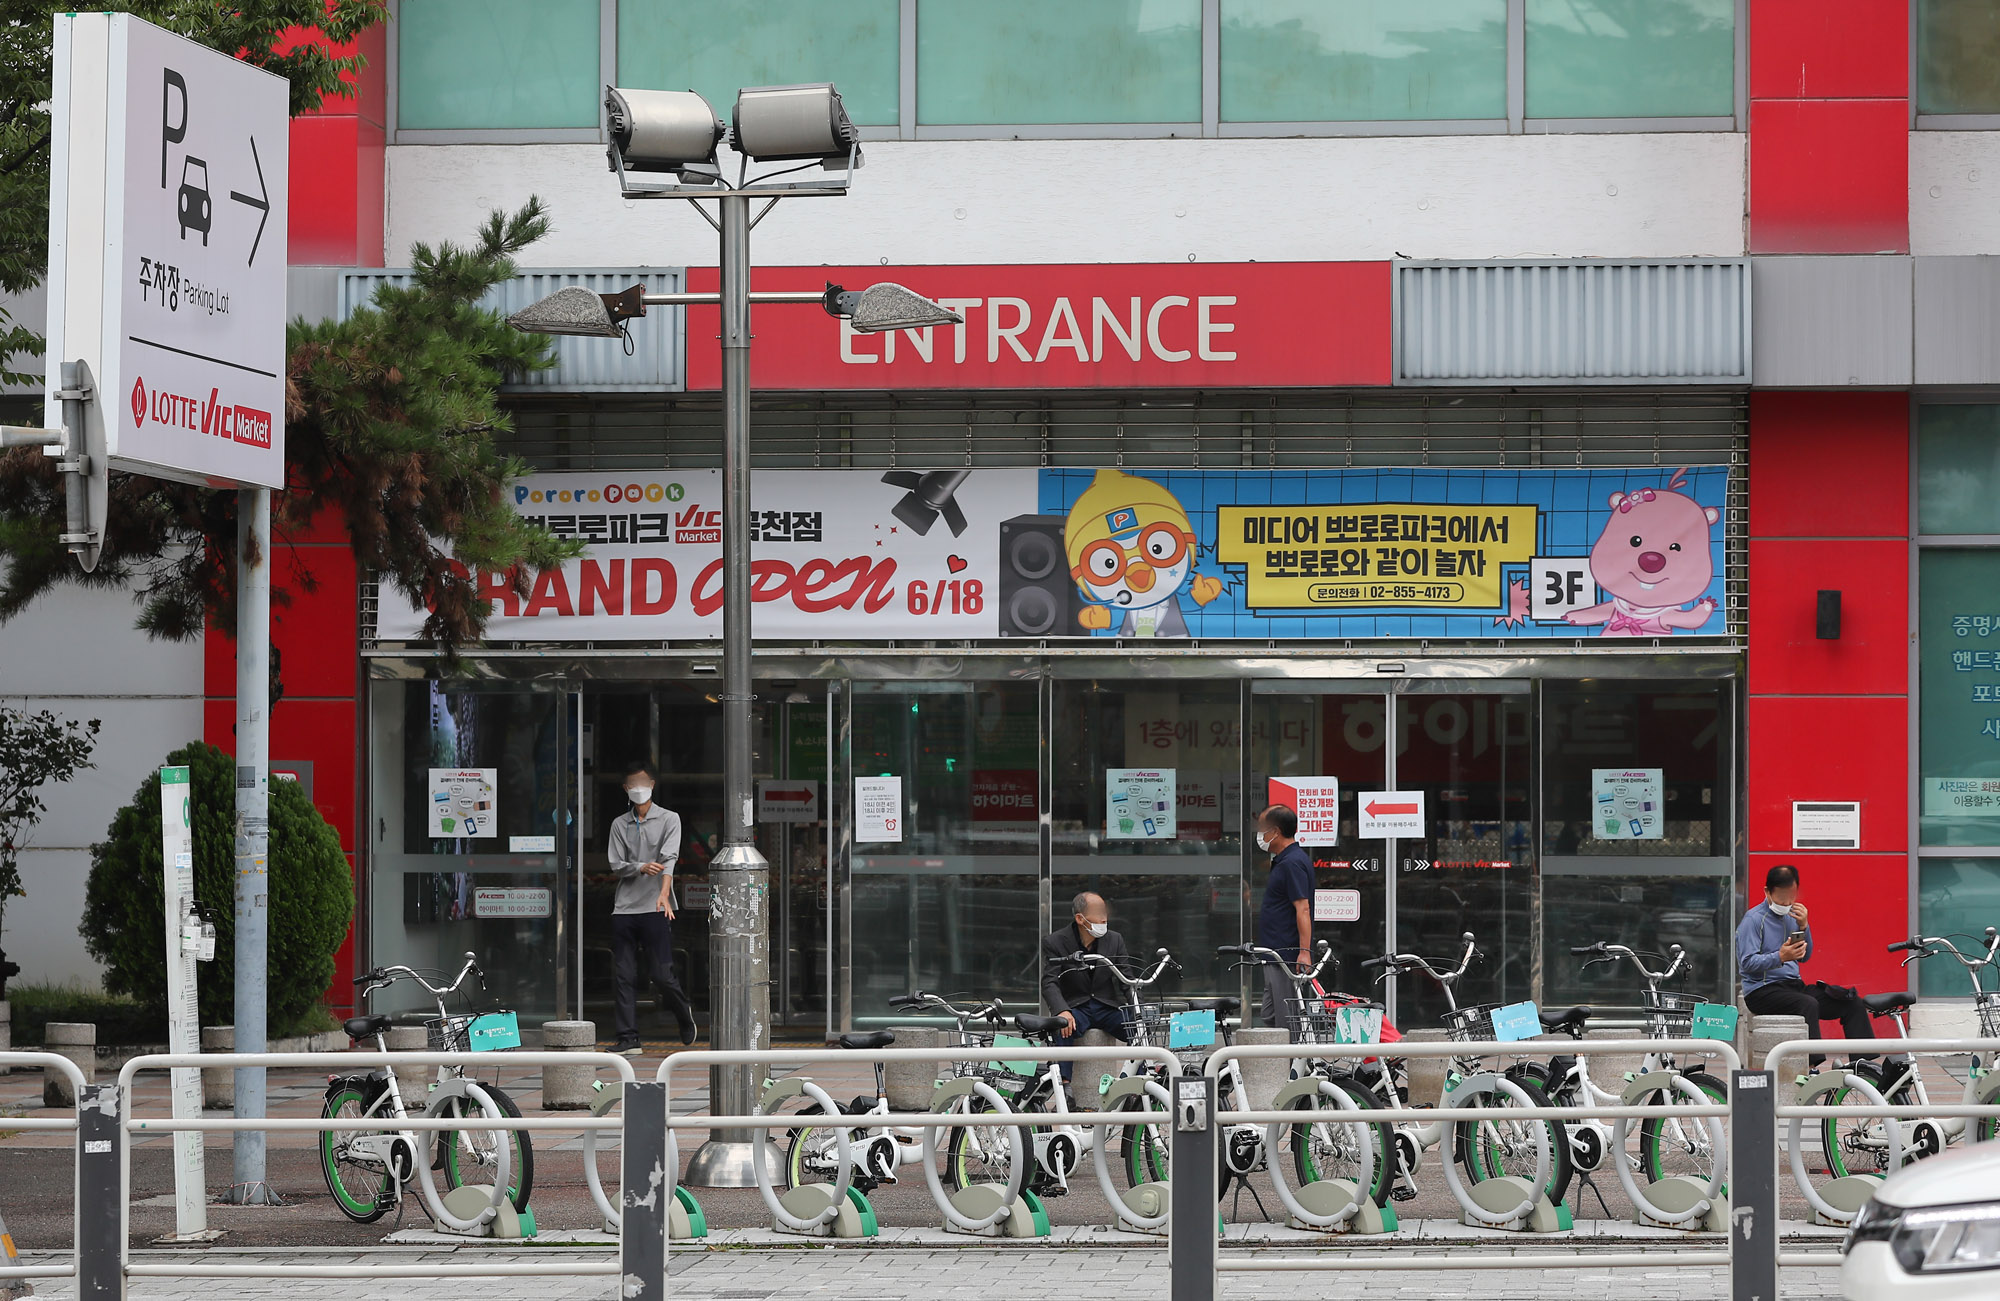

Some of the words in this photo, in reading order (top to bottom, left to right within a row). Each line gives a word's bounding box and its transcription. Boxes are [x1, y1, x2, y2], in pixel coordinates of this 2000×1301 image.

[162, 68, 188, 189] P
[139, 256, 180, 312] 주차장
[184, 278, 214, 316] Parking
[216, 288, 229, 314] Lot
[839, 296, 1237, 364] ENTRANCE
[151, 389, 197, 430] LOTTE
[201, 387, 232, 440] VIC
[236, 412, 269, 444] Market
[514, 485, 600, 505] Pororo
[675, 504, 721, 528] VIC
[752, 511, 822, 543] 천점
[678, 530, 719, 543] Market
[1243, 516, 1319, 545] 미디어
[1325, 514, 1508, 544] 뽀로로파크에서
[1265, 549, 1370, 578] 뽀로로와
[1375, 547, 1428, 578] 같이
[1435, 549, 1486, 578] 놀자
[907, 579, 984, 616] 6/18
[1317, 586, 1360, 600] 문의전화
[1370, 586, 1450, 599] 02-855-4173
[1545, 571, 1583, 605] 3F
[1139, 719, 1199, 749] 1층에
[1299, 788, 1319, 796] 연회비
[1320, 788, 1334, 796] 없이
[1938, 781, 1978, 792] 사진관은
[973, 794, 1035, 808] 하이마트
[1176, 794, 1217, 808] 이마트
[1299, 798, 1334, 808] 완전개방
[1953, 795, 1994, 807] 이용할수
[1299, 820, 1334, 832] 그대로
[1474, 859, 1490, 868] VIC
